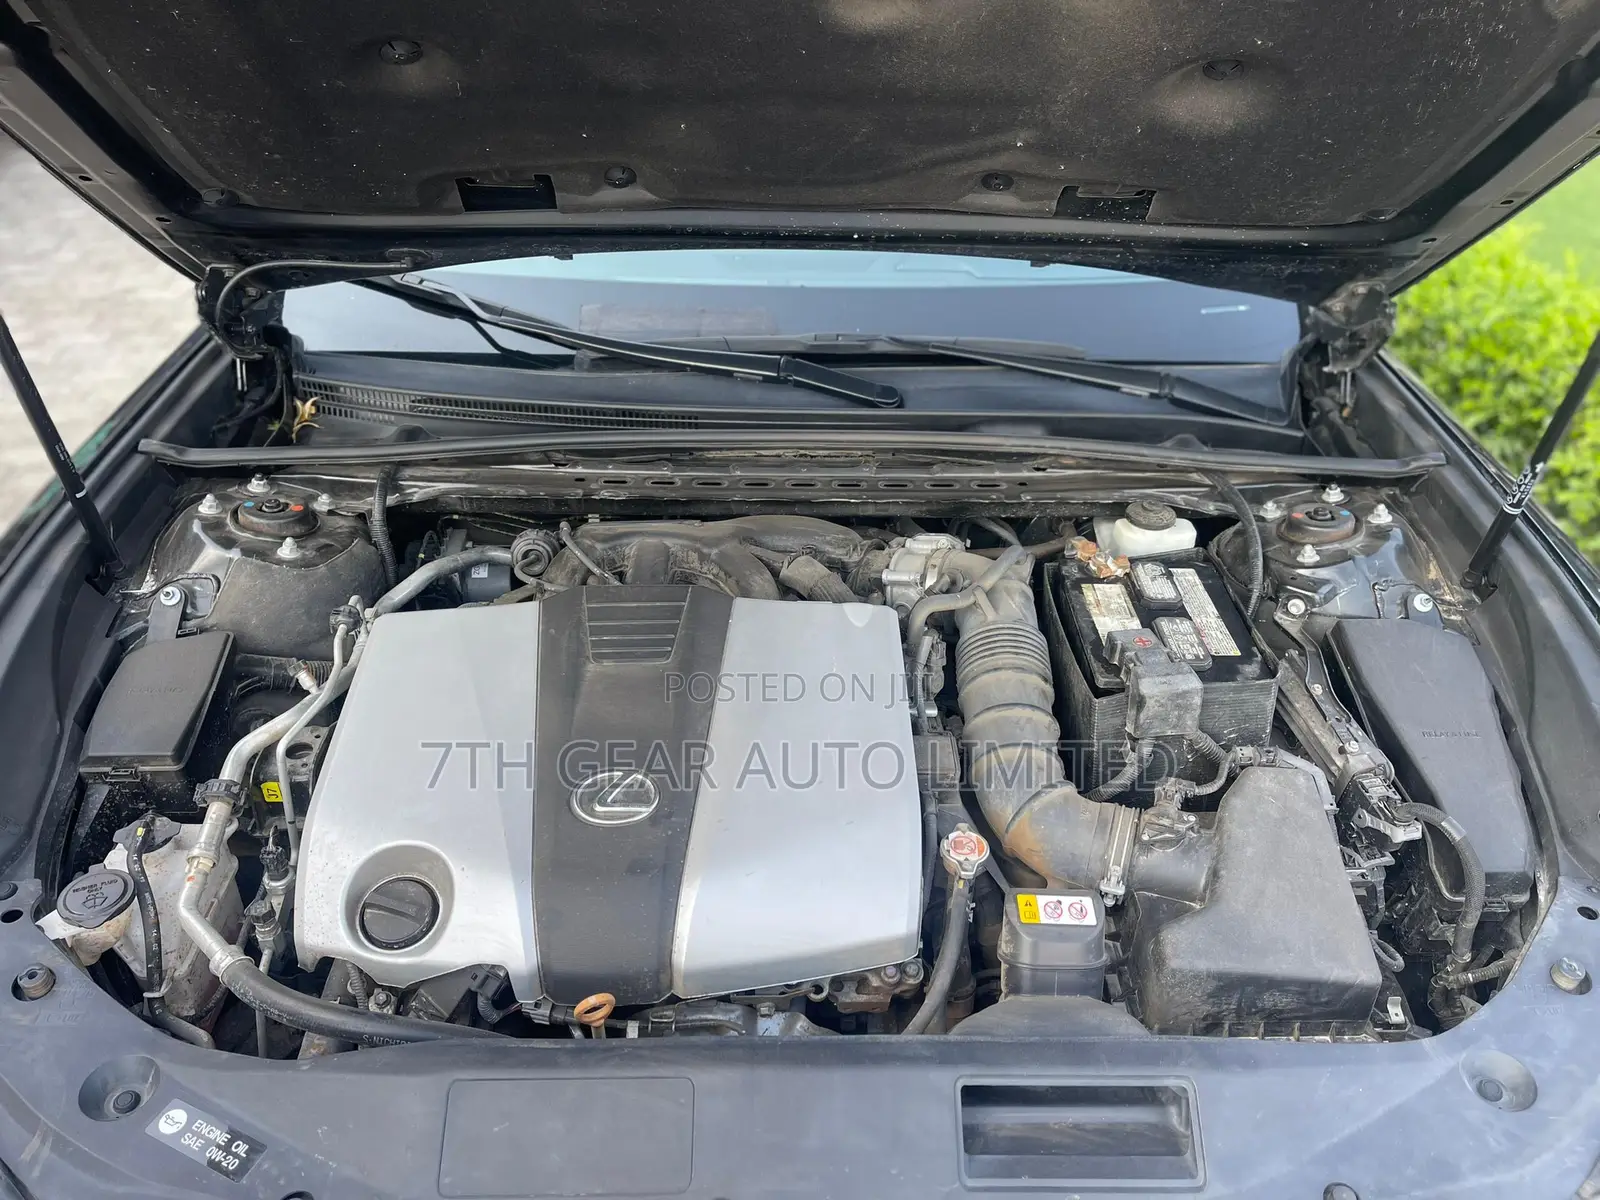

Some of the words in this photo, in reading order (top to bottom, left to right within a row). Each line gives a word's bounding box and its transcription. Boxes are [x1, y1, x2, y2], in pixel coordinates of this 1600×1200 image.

[180, 1132, 206, 1151] SAE
[205, 1146, 240, 1170] 0W-20
[191, 1119, 232, 1146] ENGINE
[231, 1140, 250, 1158] OIL
